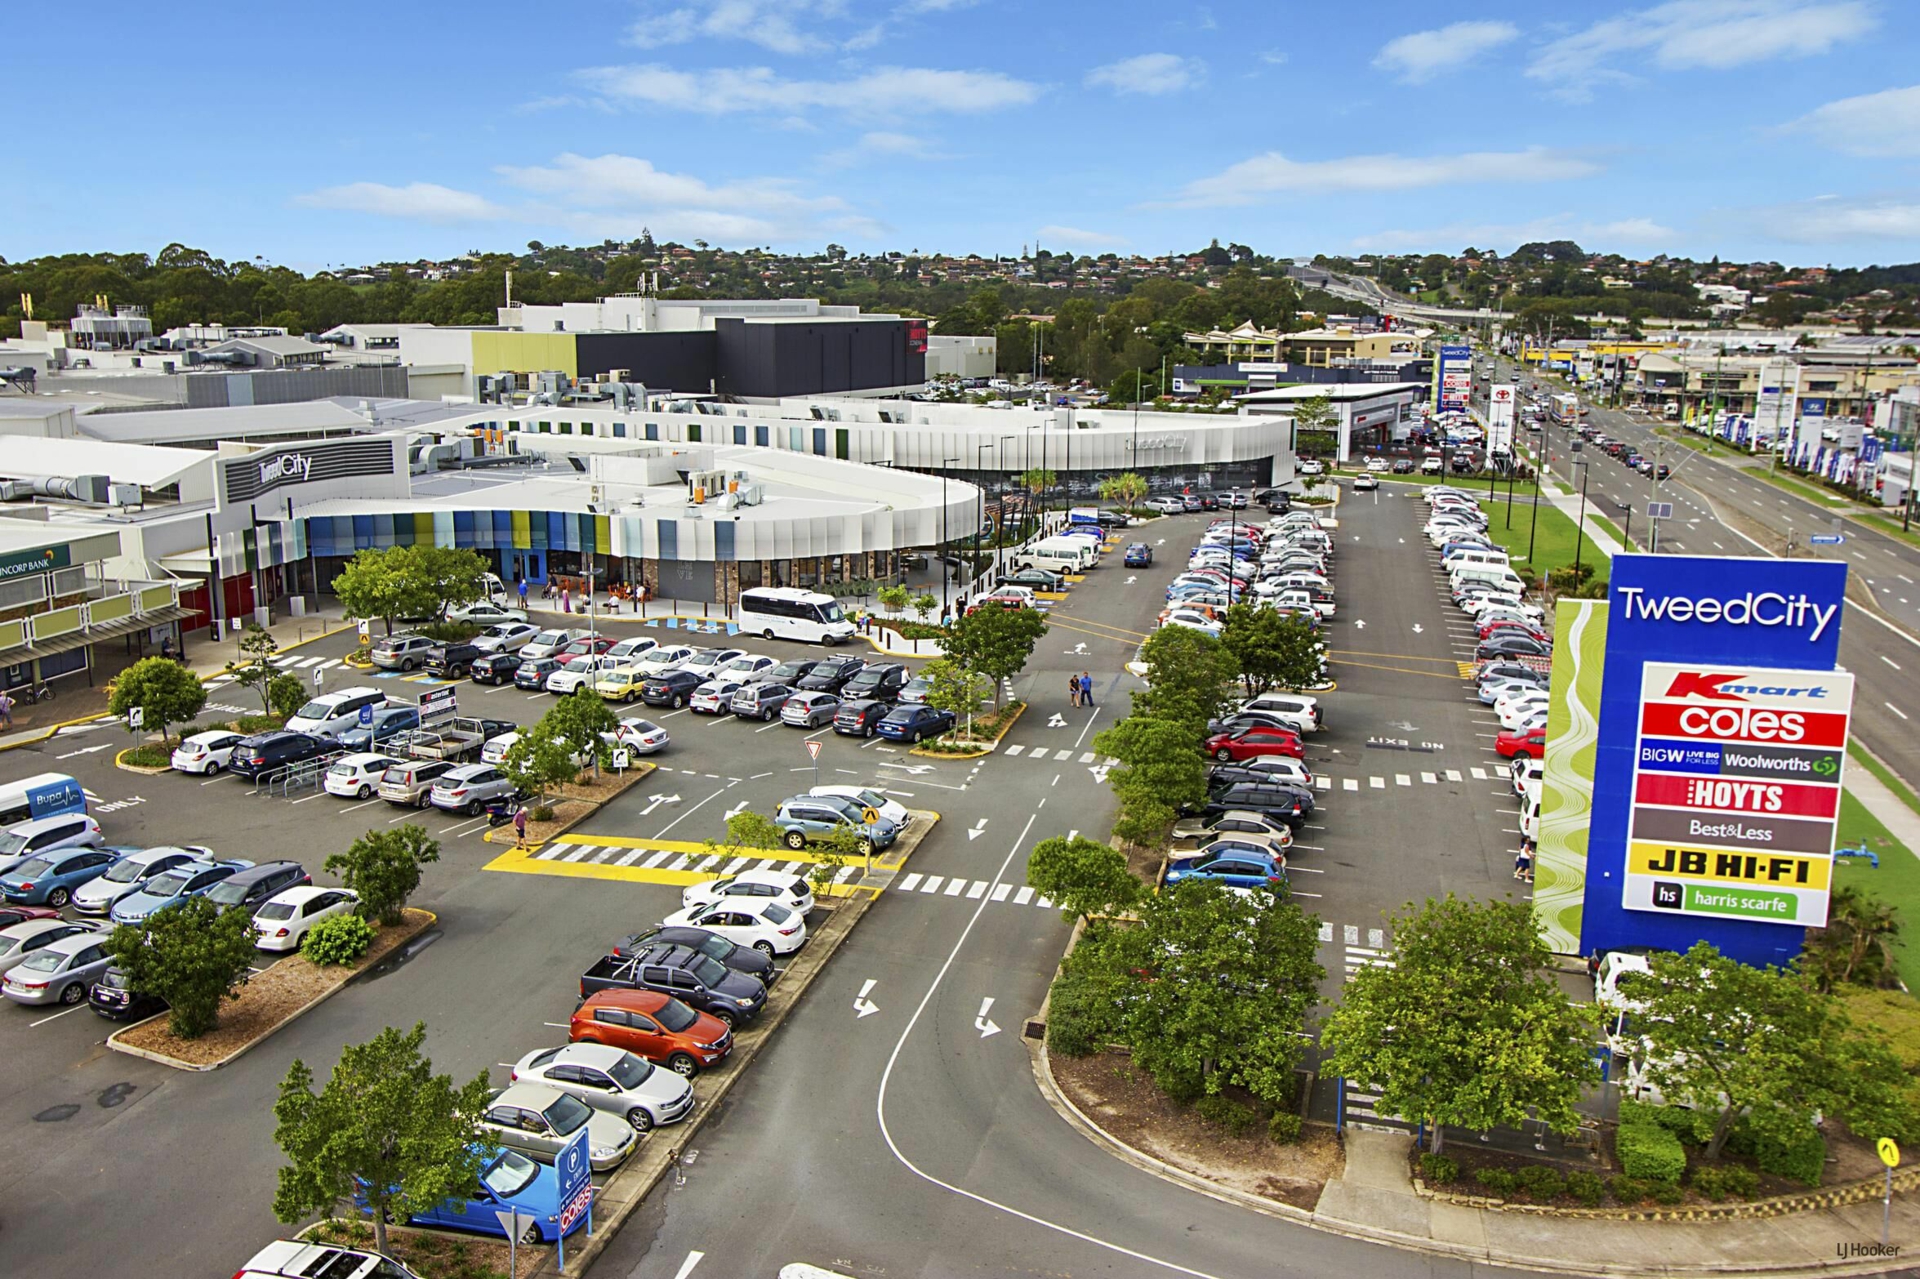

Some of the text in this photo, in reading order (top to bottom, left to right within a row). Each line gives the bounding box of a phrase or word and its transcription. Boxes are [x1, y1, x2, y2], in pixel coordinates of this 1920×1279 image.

[258, 453, 312, 483] TweedCity
[28, 558, 49, 570] BANK
[1617, 587, 1838, 642] TweedCity
[1664, 671, 1829, 702] Kmart
[1679, 707, 1805, 741] coles
[1367, 736, 1409, 747] EXIT
[1686, 750, 1720, 759] LIVE BIG
[1701, 758, 1719, 766] LESS
[1725, 753, 1811, 772] Woolworths
[37, 791, 62, 806] Bupa
[95, 795, 147, 813] ONLY
[1694, 780, 1783, 811] HOYTS
[1689, 819, 1773, 841] Best&Less
[1648, 849, 1707, 875] JB
[1659, 887, 1676, 902] hs
[1694, 890, 1788, 912] harris scarfe
[561, 1186, 591, 1228] coles
